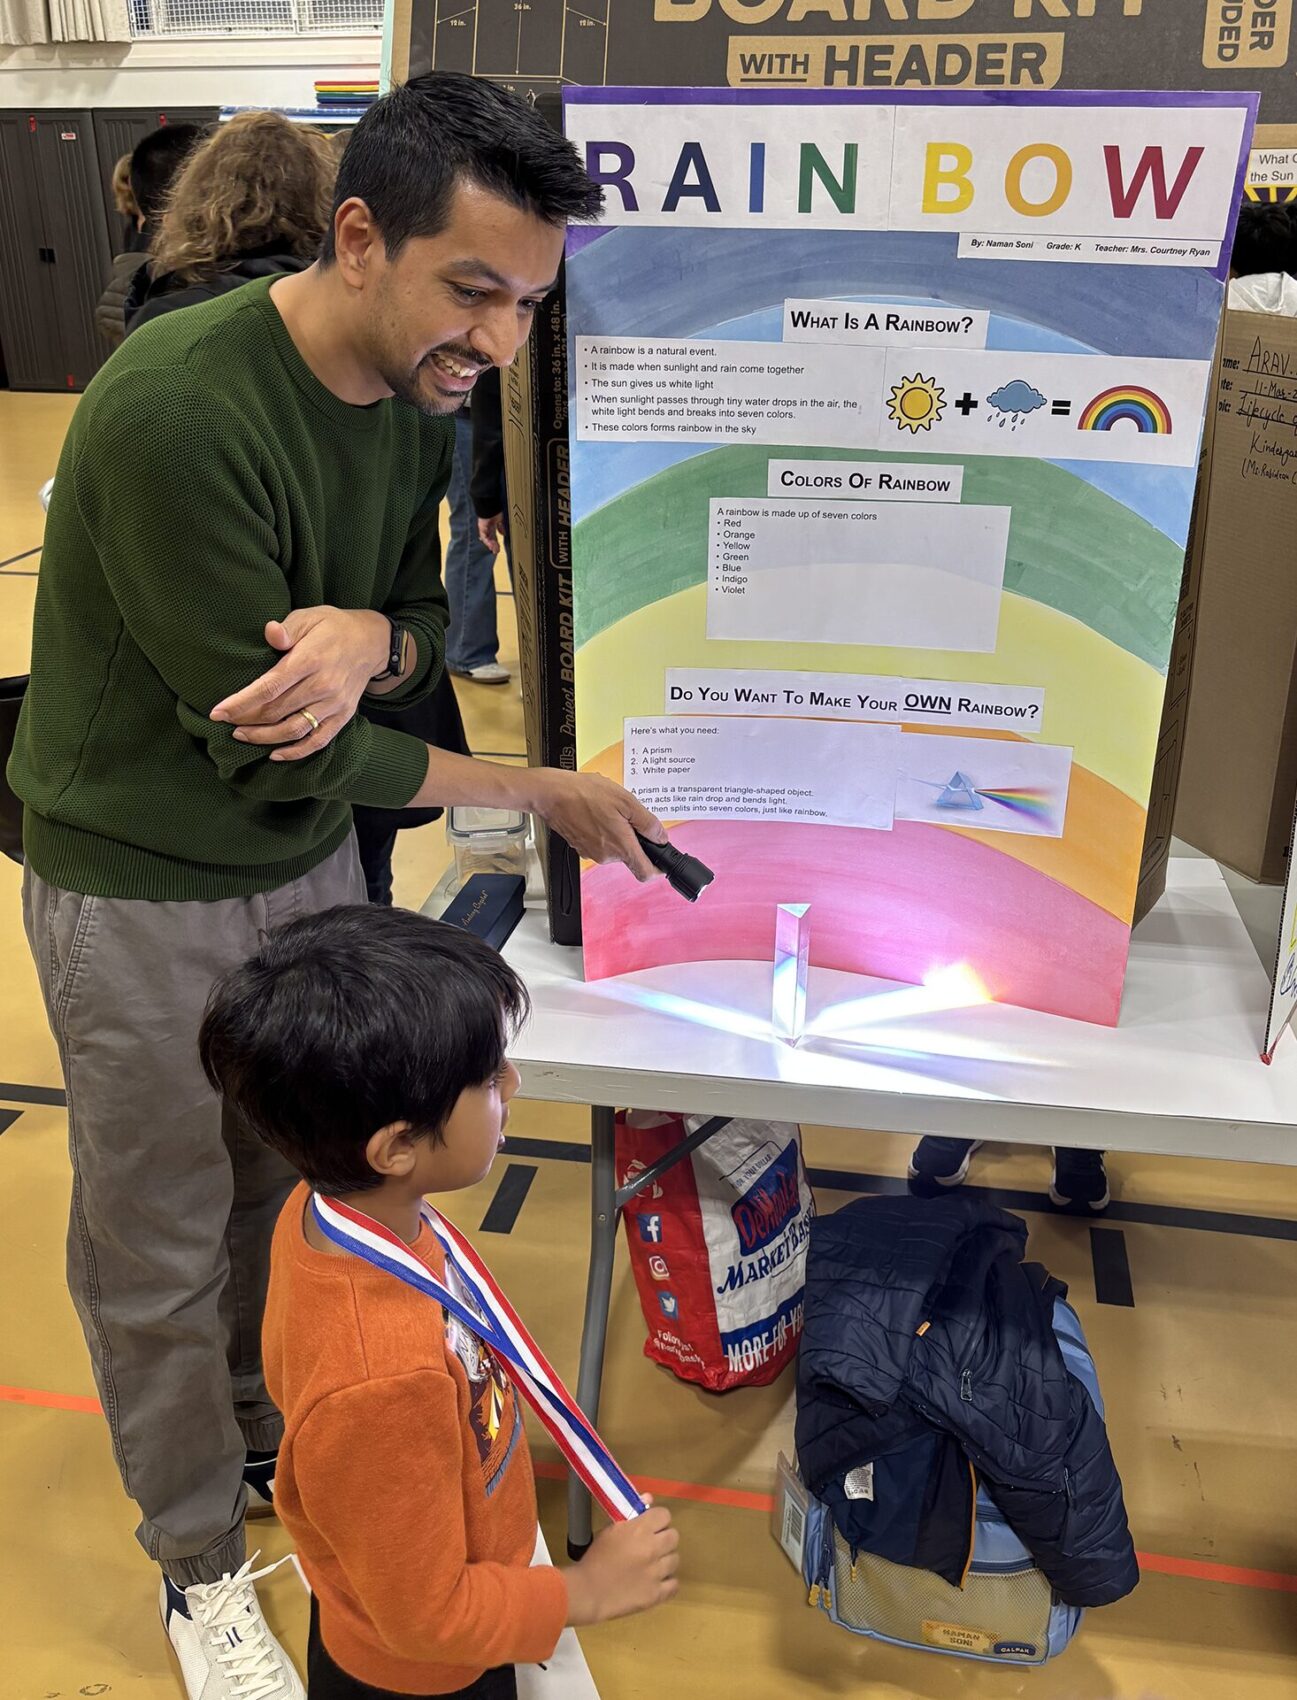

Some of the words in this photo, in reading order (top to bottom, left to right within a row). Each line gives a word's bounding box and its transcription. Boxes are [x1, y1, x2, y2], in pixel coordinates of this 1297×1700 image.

[739, 54, 809, 74] WITH
[824, 43, 1047, 86] HEADER
[1259, 154, 1288, 164] What
[1250, 172, 1268, 182] the
[1271, 170, 1294, 181] Sun
[970, 238, 984, 248] By:
[985, 239, 1014, 248] Naman
[1046, 241, 1073, 250] Grade:
[1074, 242, 1082, 250] K
[1094, 243, 1129, 252] Teacher:
[1129, 245, 1148, 253] Mrs.
[1149, 246, 1188, 256] Courtney
[1188, 247, 1210, 257] Ryan
[551, 317, 560, 332] 48
[590, 345, 598, 354] A
[599, 345, 635, 354] rainbow
[637, 345, 645, 355] is
[655, 346, 687, 355] natural
[689, 347, 716, 356] event.
[552, 360, 561, 374] 36
[591, 361, 597, 370] It
[599, 361, 607, 370] is
[609, 361, 634, 371] made
[636, 362, 661, 371] when
[663, 362, 698, 374] sunlight
[700, 363, 718, 372] and
[720, 363, 737, 372] rain
[739, 365, 764, 373] come
[766, 364, 804, 375] together
[590, 378, 609, 387] The
[629, 378, 653, 389] gives
[668, 379, 692, 388] white
[694, 379, 713, 390] light
[590, 394, 617, 404] When
[619, 394, 654, 405] sunlight
[656, 396, 688, 405] passes
[690, 395, 724, 407] through
[726, 396, 742, 407] tiny
[744, 397, 770, 406] water
[771, 397, 797, 408] drops
[799, 398, 808, 406] in
[810, 398, 824, 407] the
[826, 399, 840, 408] air,
[843, 399, 857, 408] the
[552, 394, 565, 430] Opens
[591, 406, 615, 415] white
[616, 406, 636, 417] light
[637, 407, 665, 416] bends
[667, 407, 684, 416] and
[686, 407, 716, 417] breaks
[718, 408, 735, 417] into
[737, 410, 764, 418] seven
[766, 409, 795, 419] colors.
[591, 422, 619, 431] These
[621, 422, 648, 431] colors
[650, 422, 675, 432] forms
[677, 423, 712, 432] rainbow
[714, 424, 722, 432] in
[724, 424, 739, 433] the
[741, 424, 756, 435] sky
[556, 444, 570, 527] HEADER
[716, 507, 724, 515] A
[725, 507, 760, 516] rainbow
[761, 508, 769, 517] is
[771, 509, 796, 518] made
[797, 511, 809, 520] up
[811, 509, 821, 518] of
[850, 511, 877, 520] colors
[723, 518, 741, 527] Red
[722, 529, 755, 541] Orange
[558, 531, 568, 562] WITH
[722, 541, 750, 550] Yellow
[722, 552, 749, 561] Green
[722, 563, 741, 572] Blue
[721, 574, 748, 585] Indigo
[558, 574, 572, 608] KIT
[721, 585, 745, 594] Violet
[559, 612, 574, 683] BOARD
[630, 726, 657, 735] Here's
[679, 727, 695, 735] you
[650, 746, 672, 755] prism
[641, 756, 649, 764] A
[649, 756, 667, 765] light
[667, 766, 690, 776] paper
[637, 786, 660, 795] prism
[677, 785, 722, 794] transparent
[723, 786, 785, 796] triangle-shaped
[786, 788, 814, 797] object.
[704, 794, 724, 803] drop
[742, 796, 767, 804] bends
[768, 796, 787, 805] light.
[651, 805, 668, 814] then
[670, 804, 690, 813] splits
[734, 805, 760, 814] colors,
[761, 806, 777, 814] just
[778, 806, 792, 814] like
[794, 808, 827, 817] rainbow.
[728, 1332, 769, 1372] MORE
[772, 1315, 788, 1356] FOR
